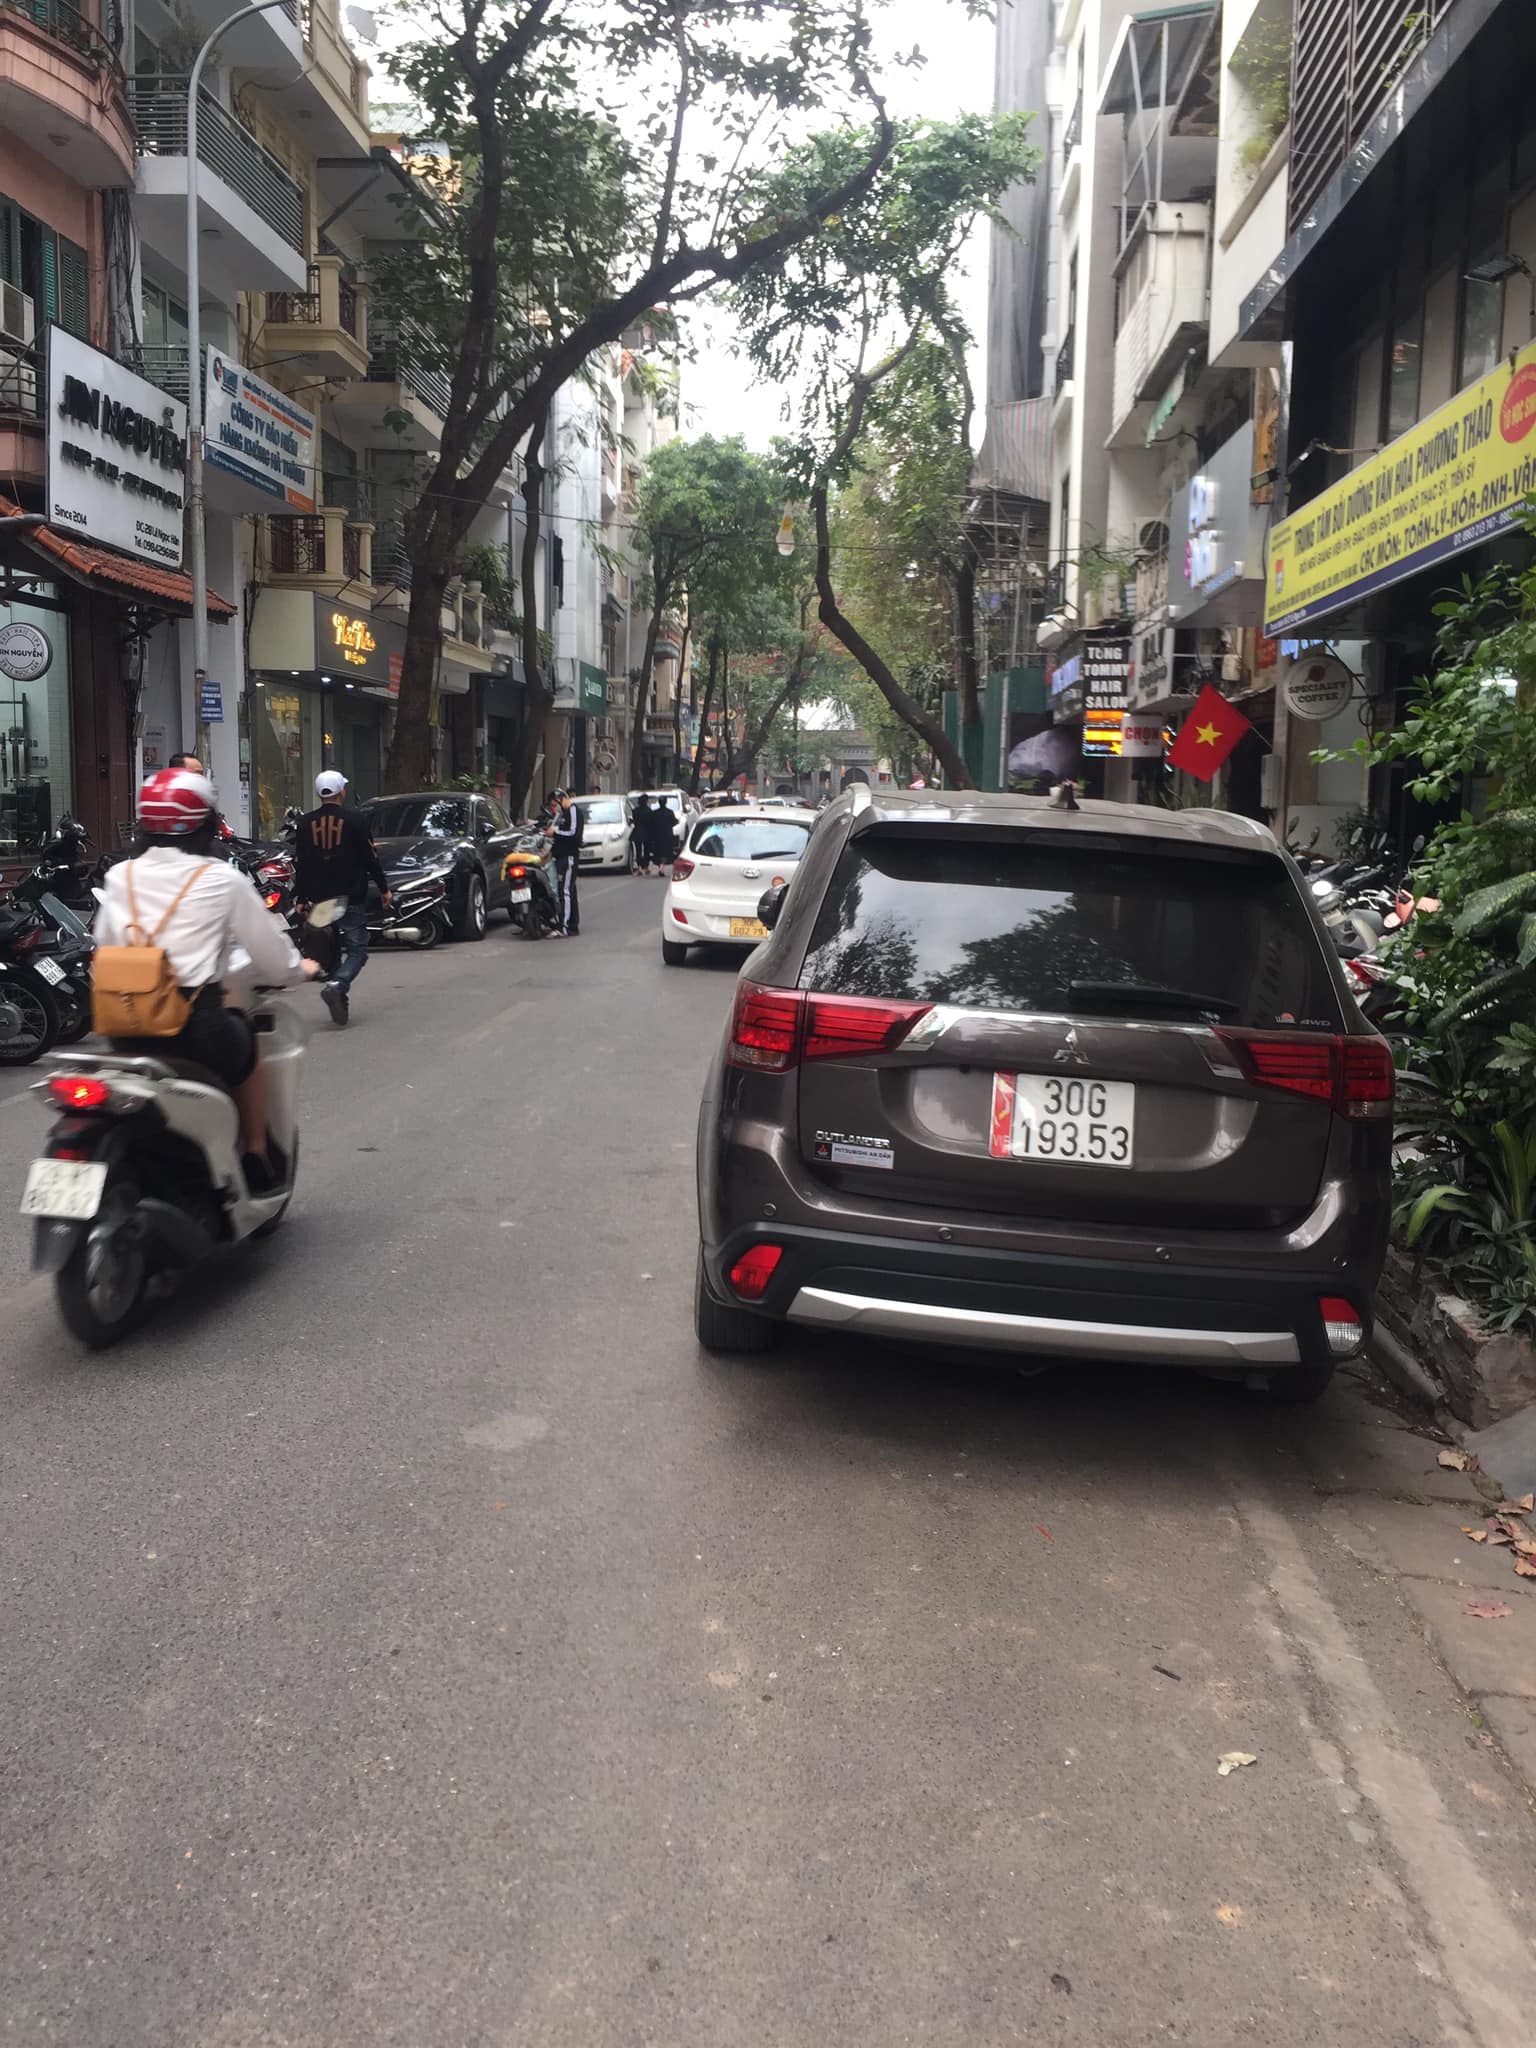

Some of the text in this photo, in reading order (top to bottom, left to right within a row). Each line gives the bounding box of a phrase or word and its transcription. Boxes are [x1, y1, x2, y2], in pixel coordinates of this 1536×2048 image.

[231, 402, 255, 431] CÔNG
[255, 415, 265, 437] TY
[1463, 386, 1493, 454] THẢO
[54, 504, 88, 525] Since 2014
[1083, 663, 1130, 677] TOMMY
[1090, 680, 1122, 693] HAIR
[1288, 681, 1347, 694] SPECIALTY
[1085, 696, 1129, 709] SALON
[1298, 692, 1339, 703] COFFEE
[1124, 727, 1160, 746] CHỌN
[1042, 1079, 1108, 1119] 30G
[815, 1130, 890, 1149] OUTLANDER
[1020, 1119, 1130, 1162] 193.53
[834, 1146, 868, 1157] MITSUBISHI
